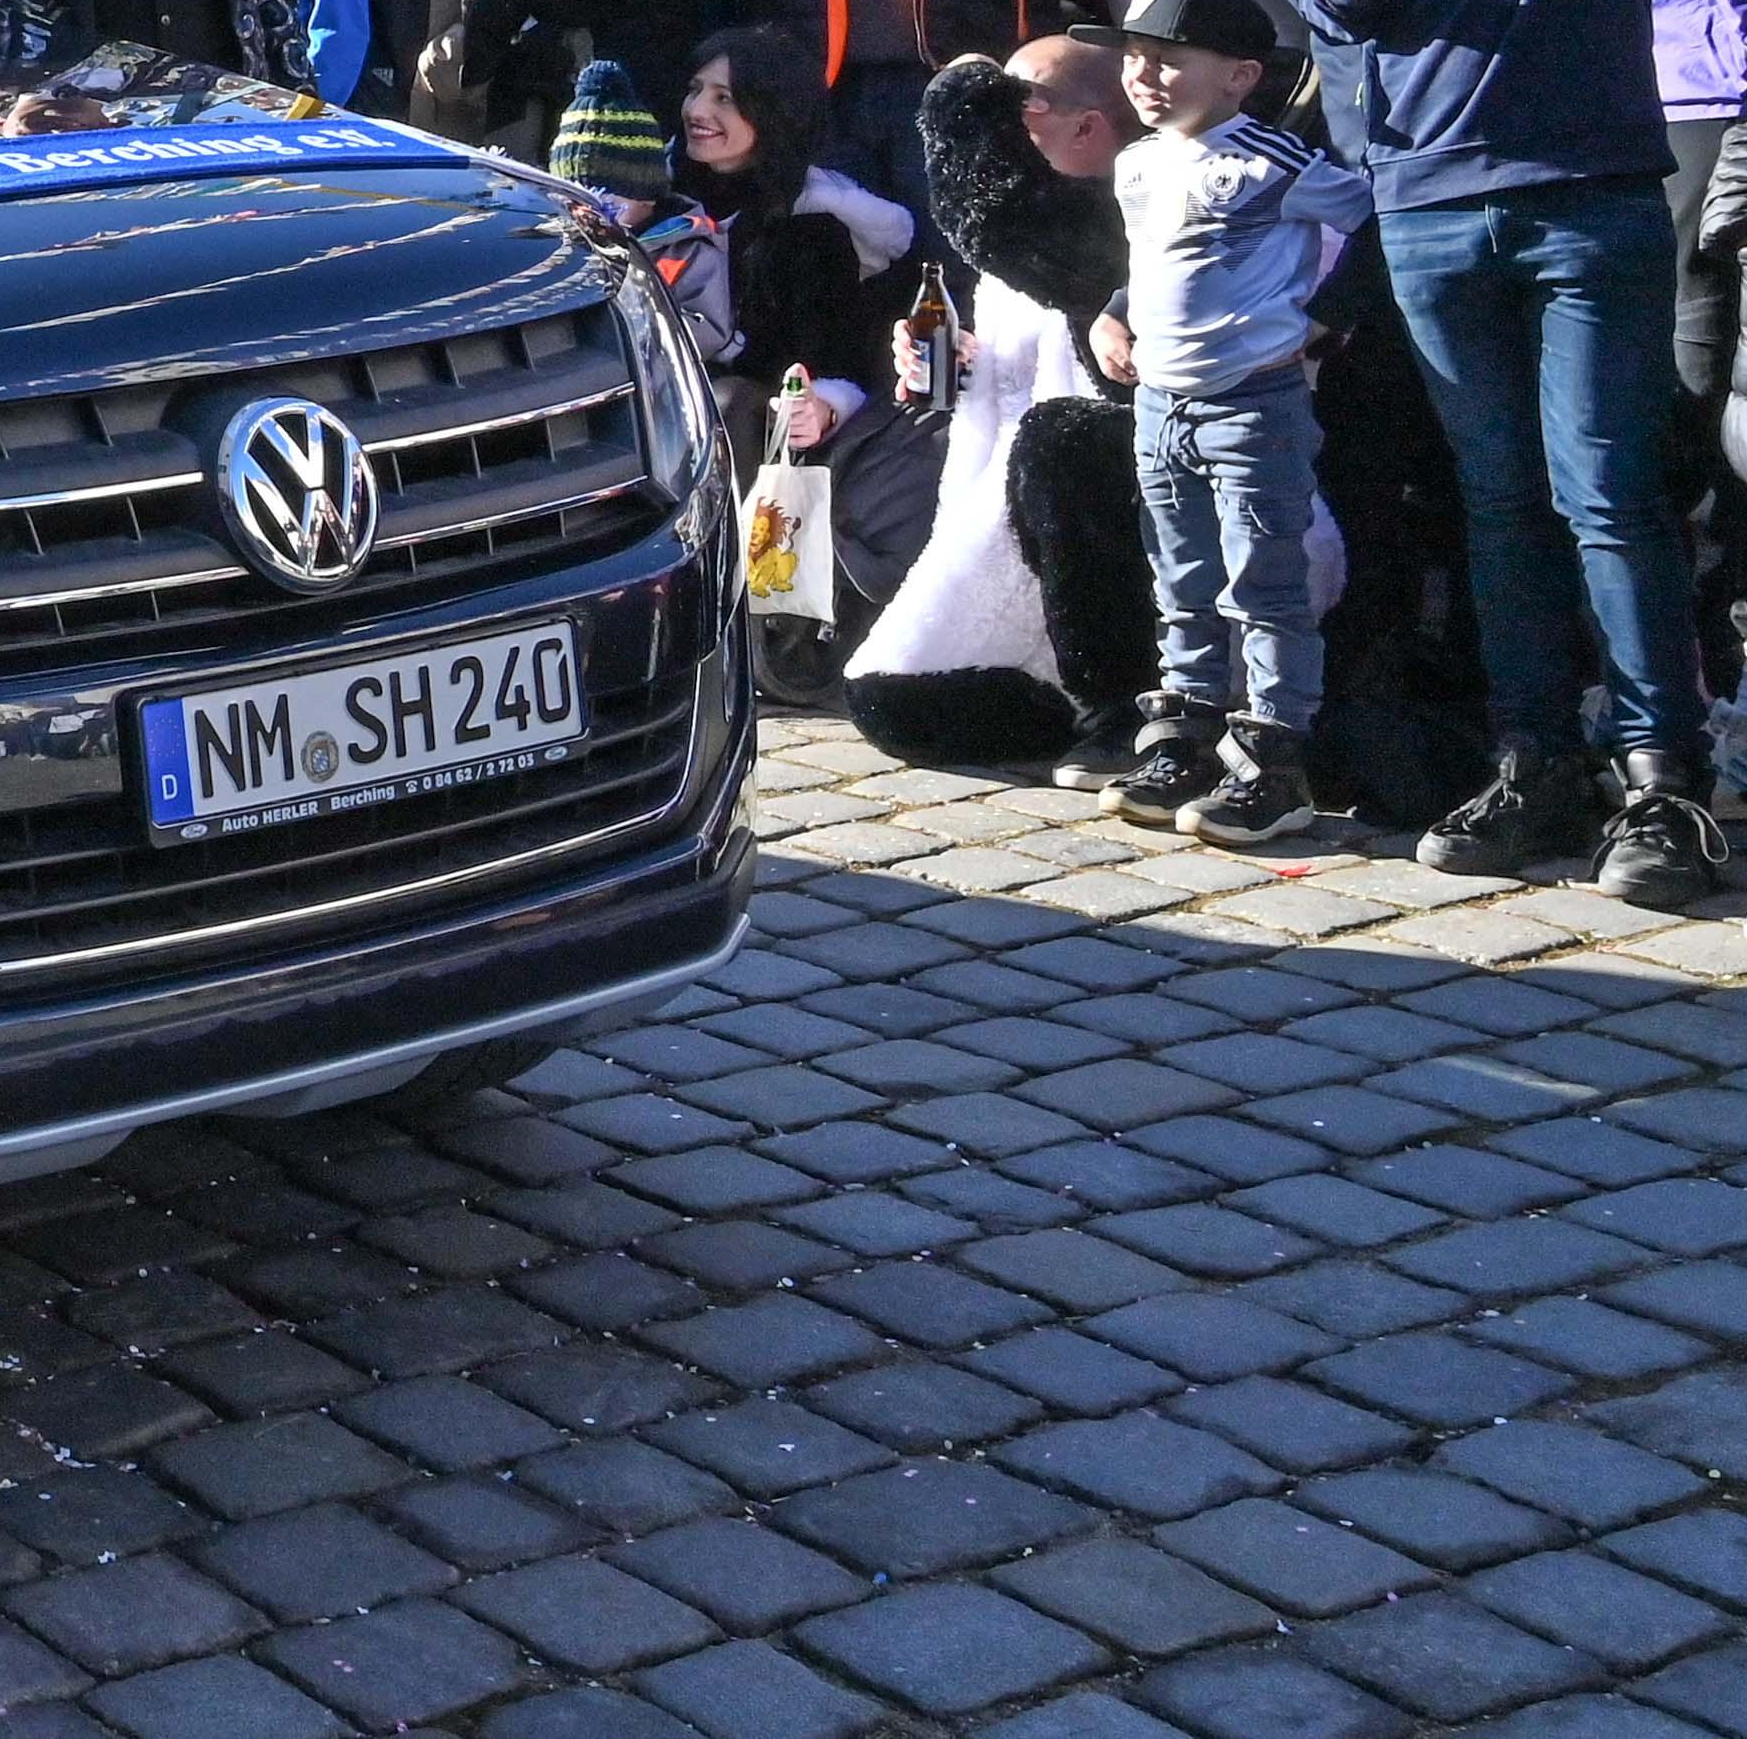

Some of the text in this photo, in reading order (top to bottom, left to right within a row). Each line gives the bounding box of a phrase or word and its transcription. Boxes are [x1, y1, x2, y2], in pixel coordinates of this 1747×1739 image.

[296, 128, 397, 149] e.V.
[161, 637, 571, 801] D NM SH 240
[221, 813, 259, 834] Auto
[261, 800, 320, 828] HERLER
[330, 783, 396, 813] Berching
